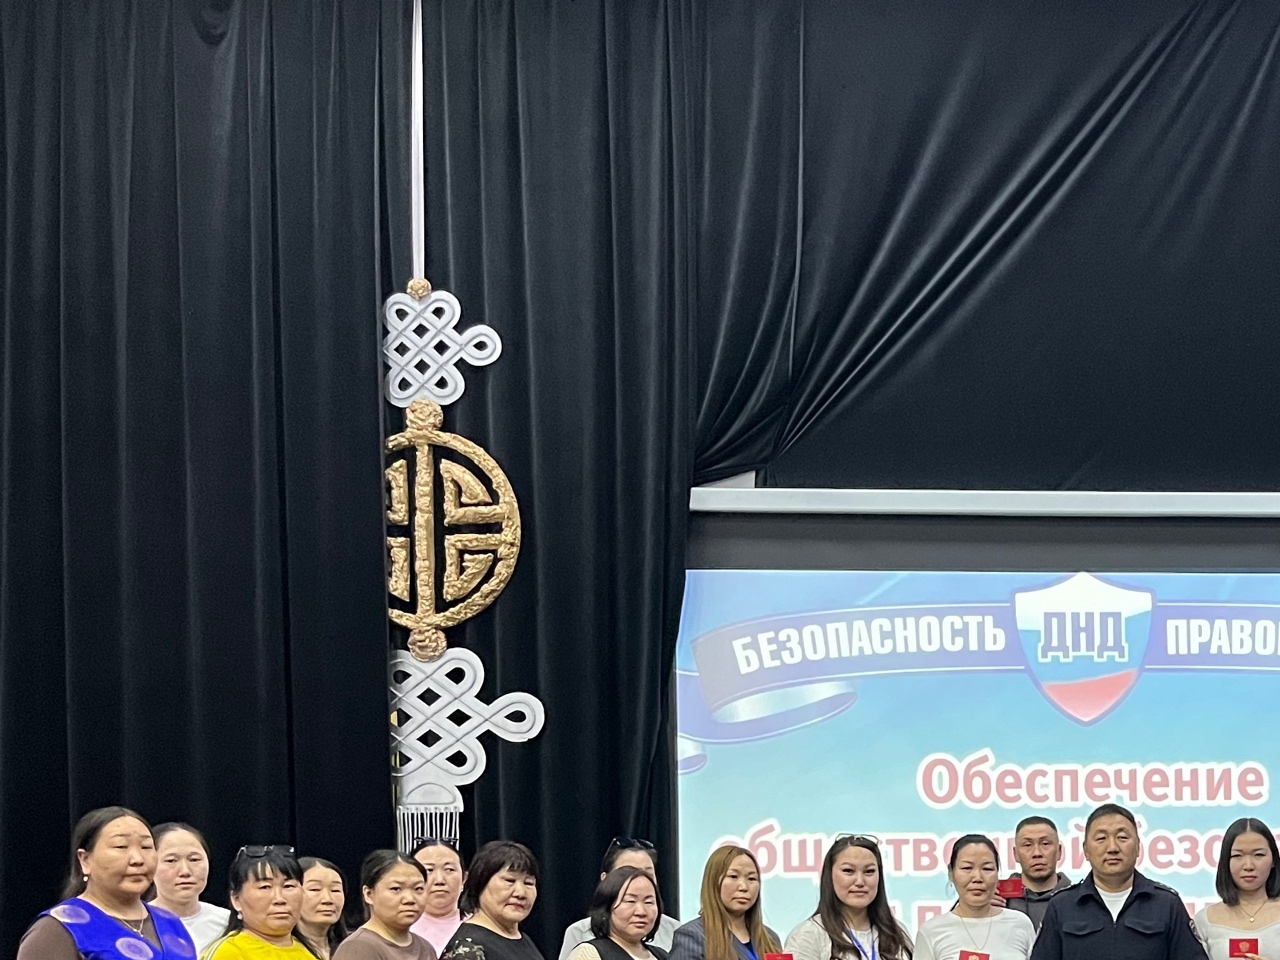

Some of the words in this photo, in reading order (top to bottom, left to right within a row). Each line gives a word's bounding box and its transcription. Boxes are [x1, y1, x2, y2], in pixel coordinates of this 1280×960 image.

[732, 615, 1006, 675] БЕЗОПАСНОСТЬ
[1039, 611, 1127, 661] ДНД
[922, 754, 1265, 804] Обеспечение
